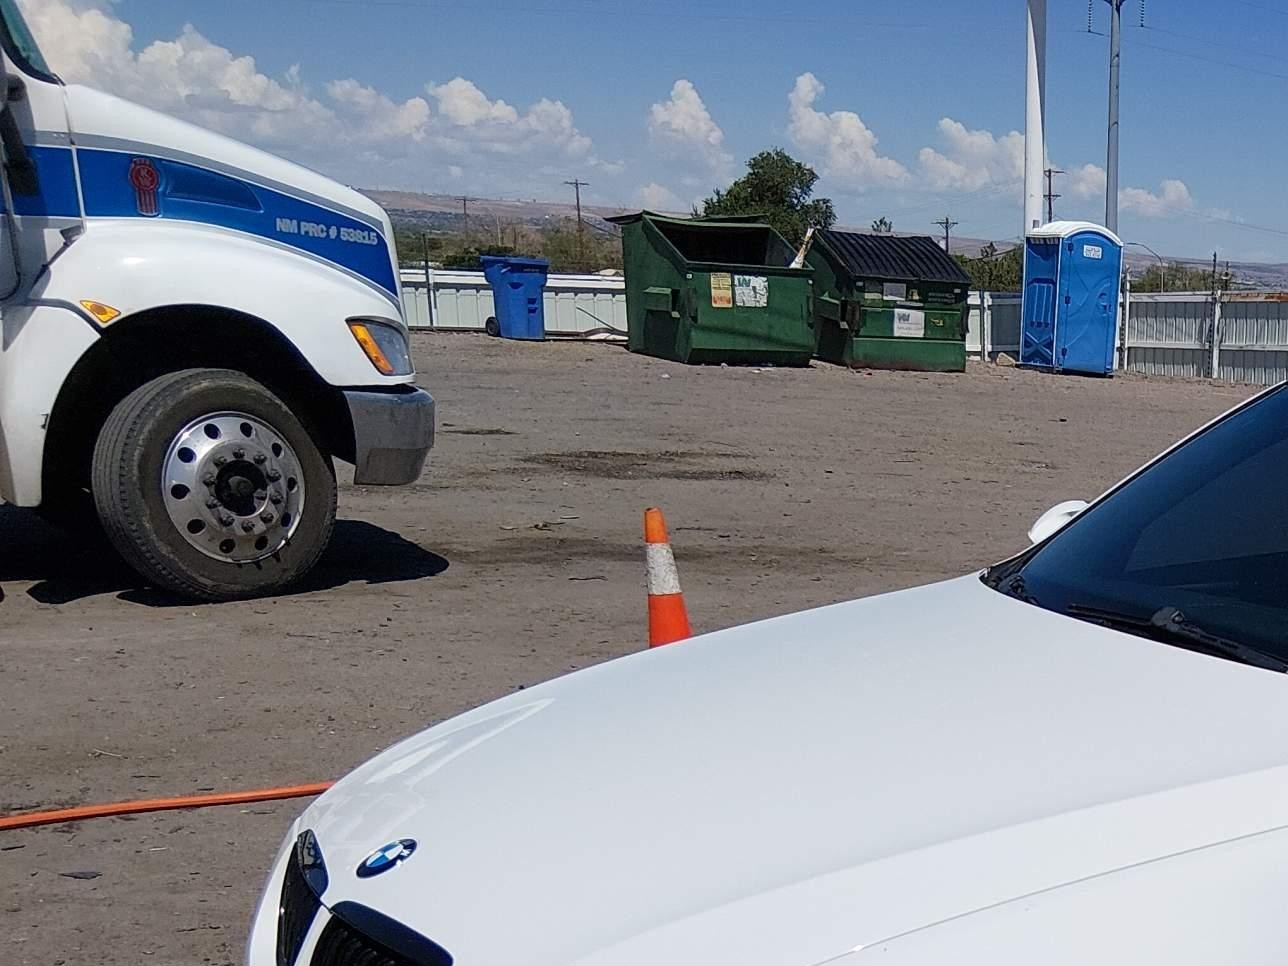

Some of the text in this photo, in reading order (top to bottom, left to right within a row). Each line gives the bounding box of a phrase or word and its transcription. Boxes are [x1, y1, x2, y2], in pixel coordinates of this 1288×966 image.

[275, 217, 298, 234] NM
[300, 221, 328, 238] PRC
[328, 225, 338, 240] #
